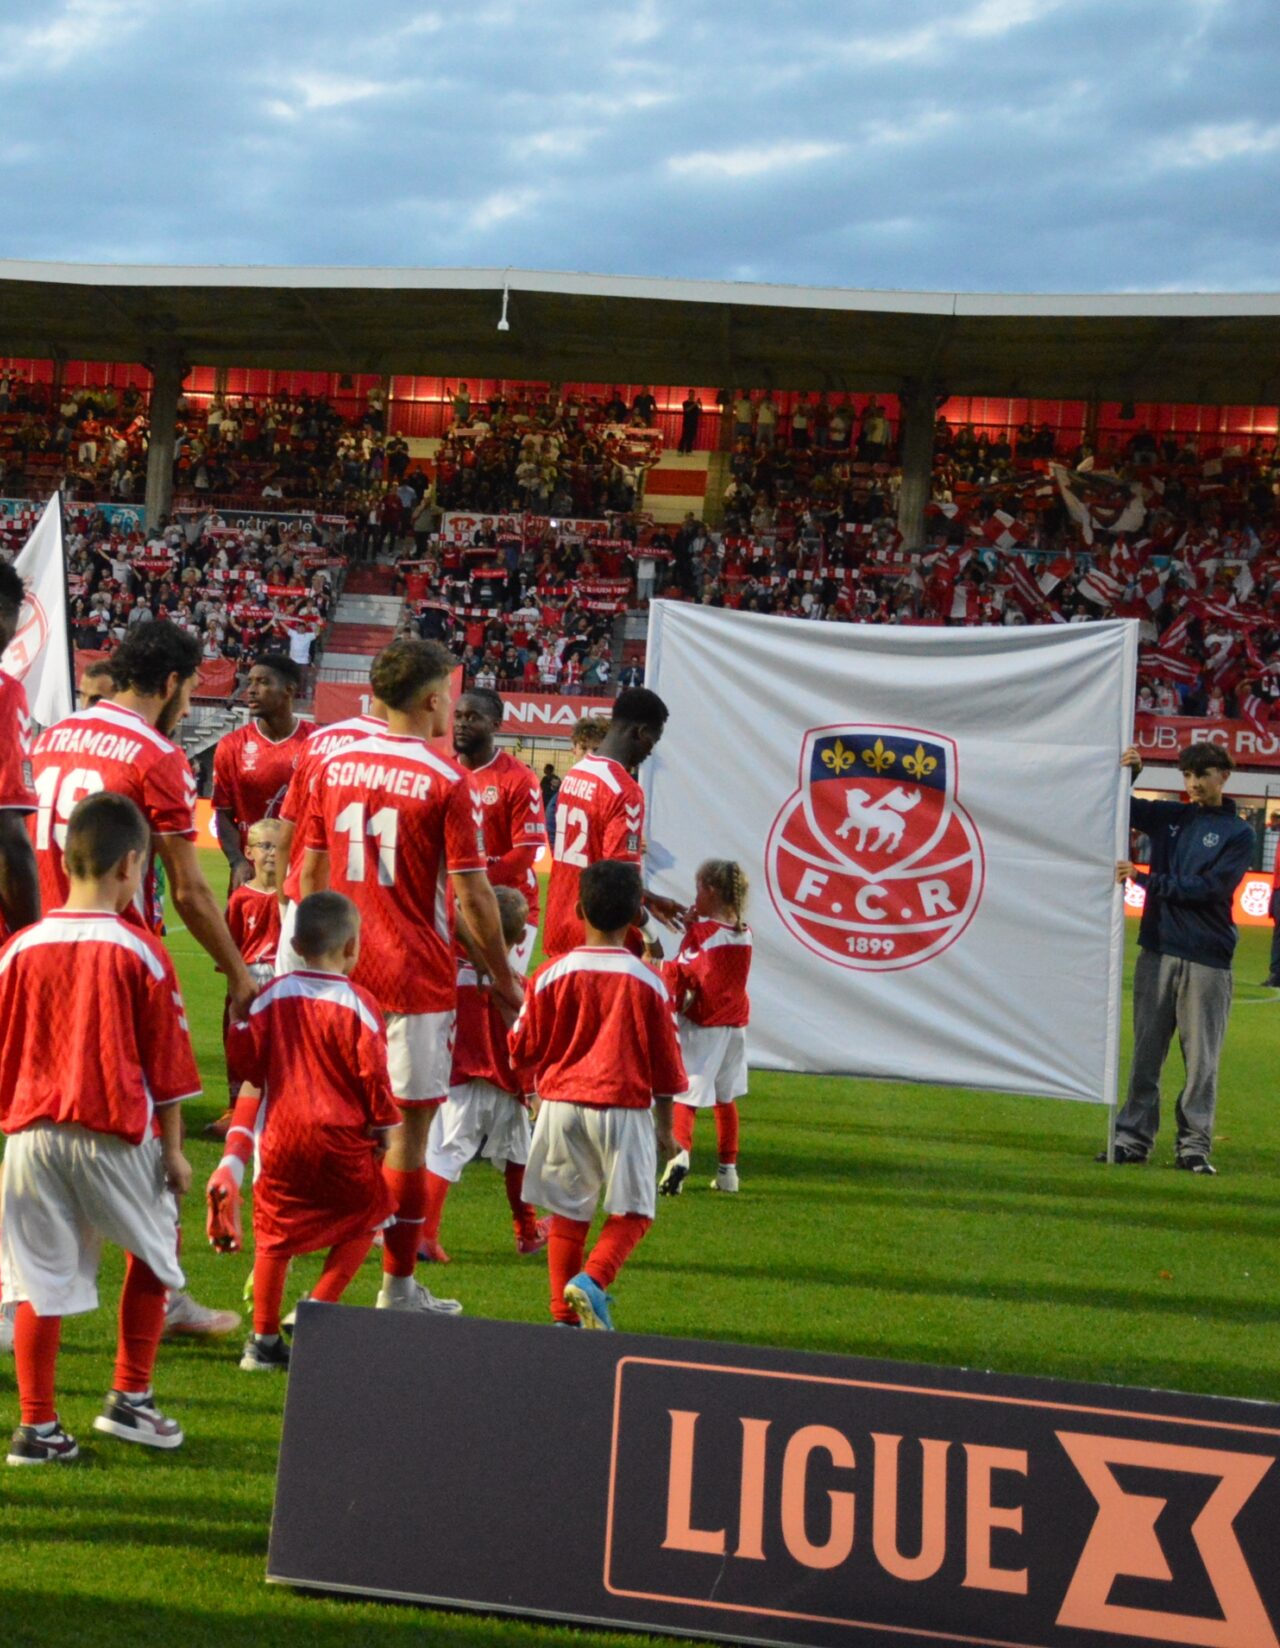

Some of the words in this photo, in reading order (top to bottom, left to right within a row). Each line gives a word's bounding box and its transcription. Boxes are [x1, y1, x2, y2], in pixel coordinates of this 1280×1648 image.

[326, 761, 433, 801] SOMMER
[335, 802, 399, 887] 11
[554, 803, 589, 868] 12
[845, 937, 896, 956] 1899
[660, 1408, 1029, 1595] LIGUE
